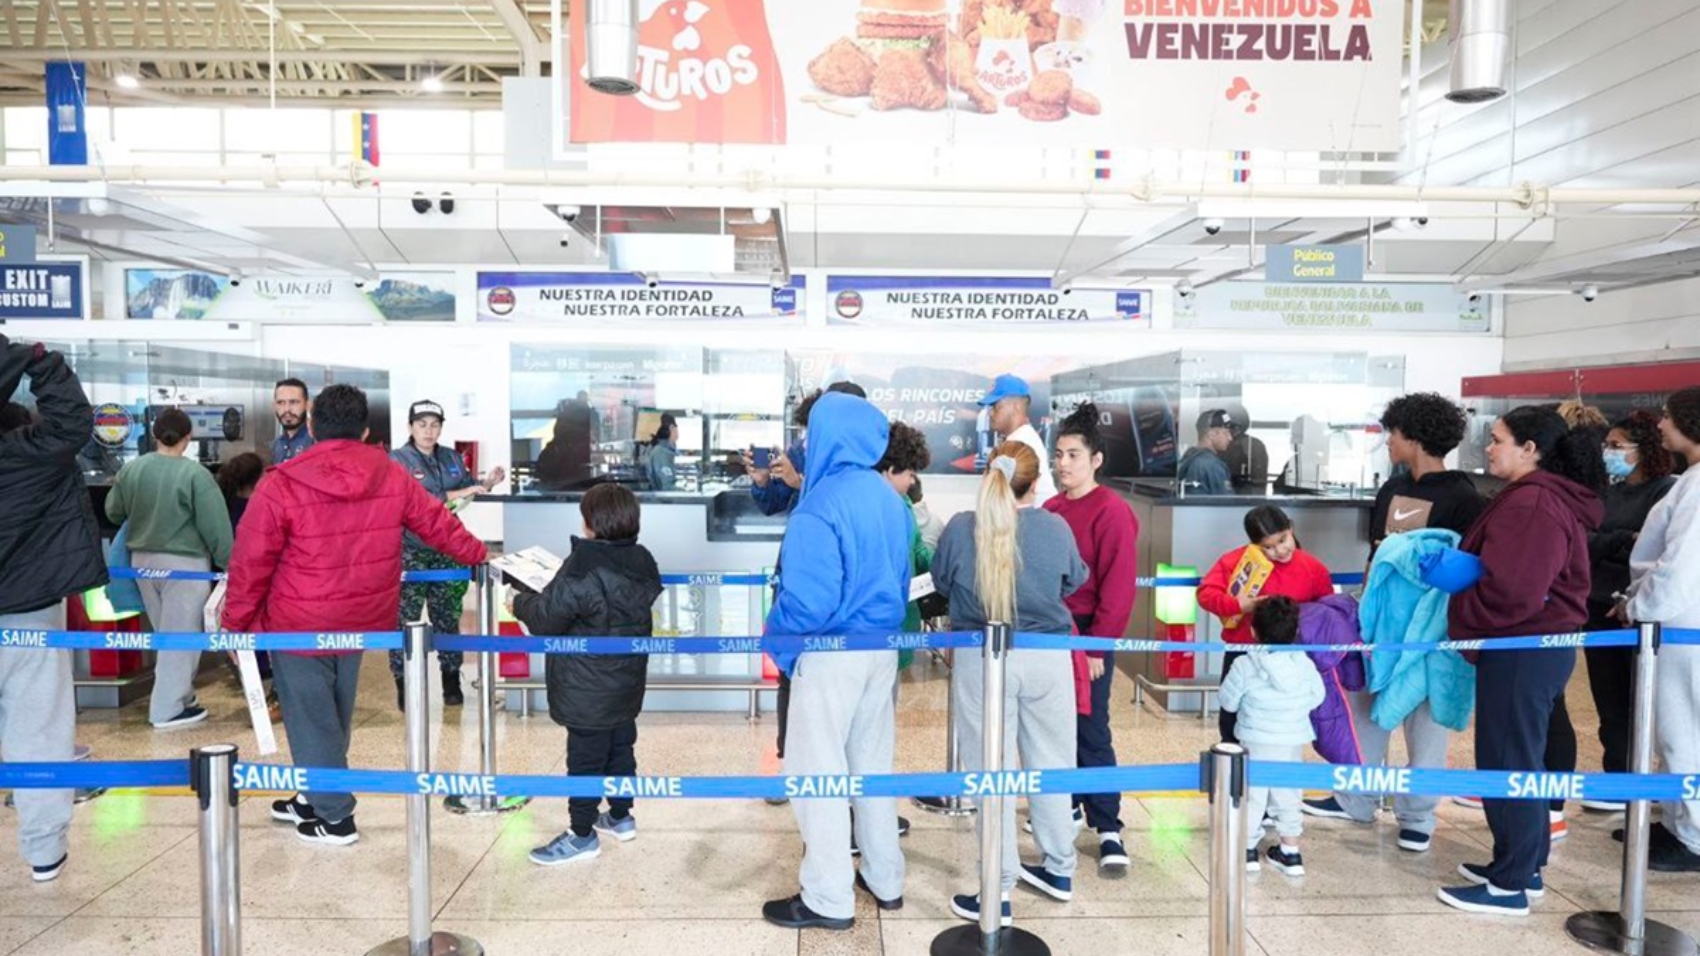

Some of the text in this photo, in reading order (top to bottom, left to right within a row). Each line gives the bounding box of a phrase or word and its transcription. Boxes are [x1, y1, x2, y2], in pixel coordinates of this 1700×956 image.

[1349, 0, 1372, 17] A
[1123, 22, 1373, 61] VENEZUELA
[580, 45, 759, 106] TUROS
[1294, 248, 1335, 262] Público
[5, 269, 49, 290] EXIT
[1293, 264, 1335, 278] General
[539, 289, 713, 302] NUESTRA IDENTIDAD
[886, 292, 1059, 306] NUESTRA IDENTIDAD
[564, 303, 744, 318] NUESTRA FORTALEZA
[911, 307, 1089, 321] NUESTRA FORTALEZA
[901, 388, 986, 402] RINCONES
[884, 404, 956, 424] EL PAÍS
[688, 575, 723, 586] SAIME
[1, 629, 364, 650] SAIME SAIME SAIME SAIME
[544, 634, 929, 653] SAIME SAIME SAIME SAIME SAIME
[1114, 638, 1163, 651] SAIME
[1437, 639, 1486, 651] SAIME
[1540, 632, 1587, 648] SAIME
[233, 764, 1042, 797] SAIME SAIME SAIME SAIME SAIME
[1332, 766, 1585, 799] SAIME SAIME
